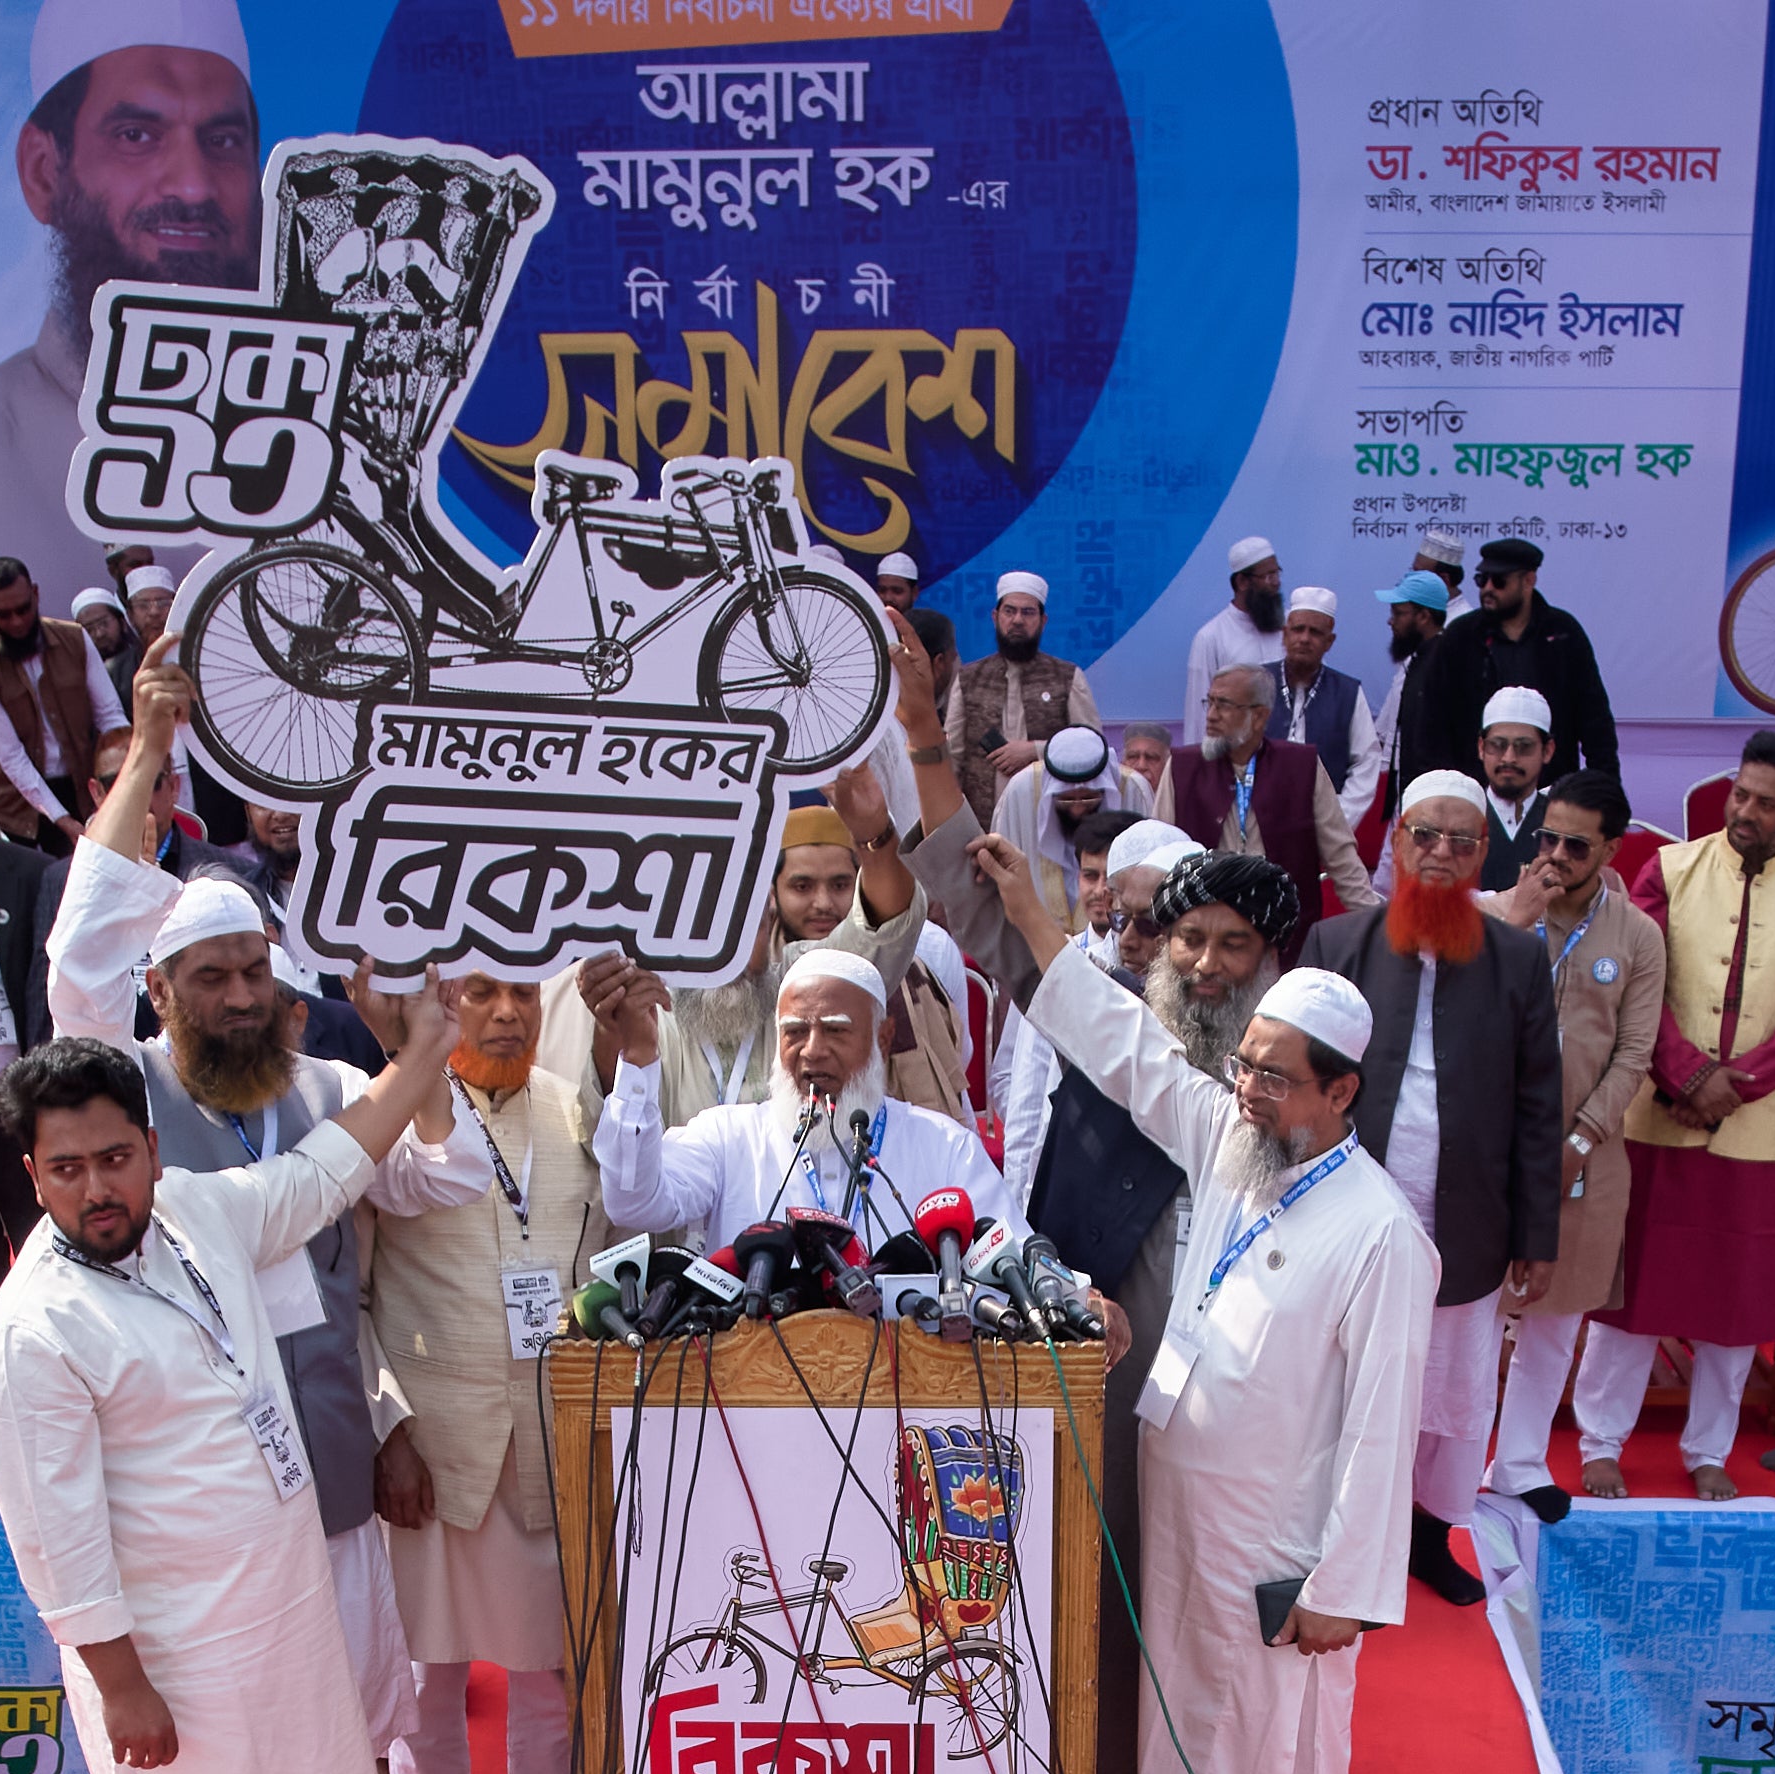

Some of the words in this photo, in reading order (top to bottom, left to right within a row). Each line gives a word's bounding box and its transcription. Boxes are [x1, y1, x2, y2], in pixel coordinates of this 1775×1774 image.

[637, 62, 870, 139] আল্লামা
[1368, 96, 1442, 128] প্রধান
[1452, 89, 1544, 128] অতিথি
[578, 148, 813, 231] মামুনুল
[831, 146, 934, 213] হক
[1443, 131, 1581, 193] শফিকুর
[1594, 146, 1721, 184] রহমান
[1366, 192, 1422, 216] আমীর,
[1429, 193, 1509, 214] বাংলাদেশ
[1601, 191, 1666, 215] ইসলামী
[1362, 248, 1446, 286] বিশেষ
[1456, 248, 1547, 286] অতিথি
[1361, 301, 1434, 339] মোঃ
[1448, 288, 1548, 340] নাহিদ
[1559, 291, 1684, 342] ইসলাম
[113, 309, 356, 412] ঢাকা
[1449, 347, 1502, 368] জাতীয়
[1509, 346, 1571, 367] নাগরিক
[1578, 345, 1616, 368] পার্টি
[452, 280, 1017, 555] সমাবেশ
[1355, 399, 1468, 437] সভাপতি
[89, 408, 335, 531] ১৩
[1454, 442, 1625, 489] মাহফুজুল
[1635, 442, 1694, 478] হক
[1352, 496, 1396, 514] প্রধান
[1402, 494, 1467, 516] উপদেষ্টা
[1352, 517, 1407, 540] নির্বাচন
[1558, 521, 1628, 540] ঢাকা-১৩
[379, 713, 591, 782] মামুনুল
[596, 725, 767, 788] হকের
[336, 800, 742, 941] রিকশা
